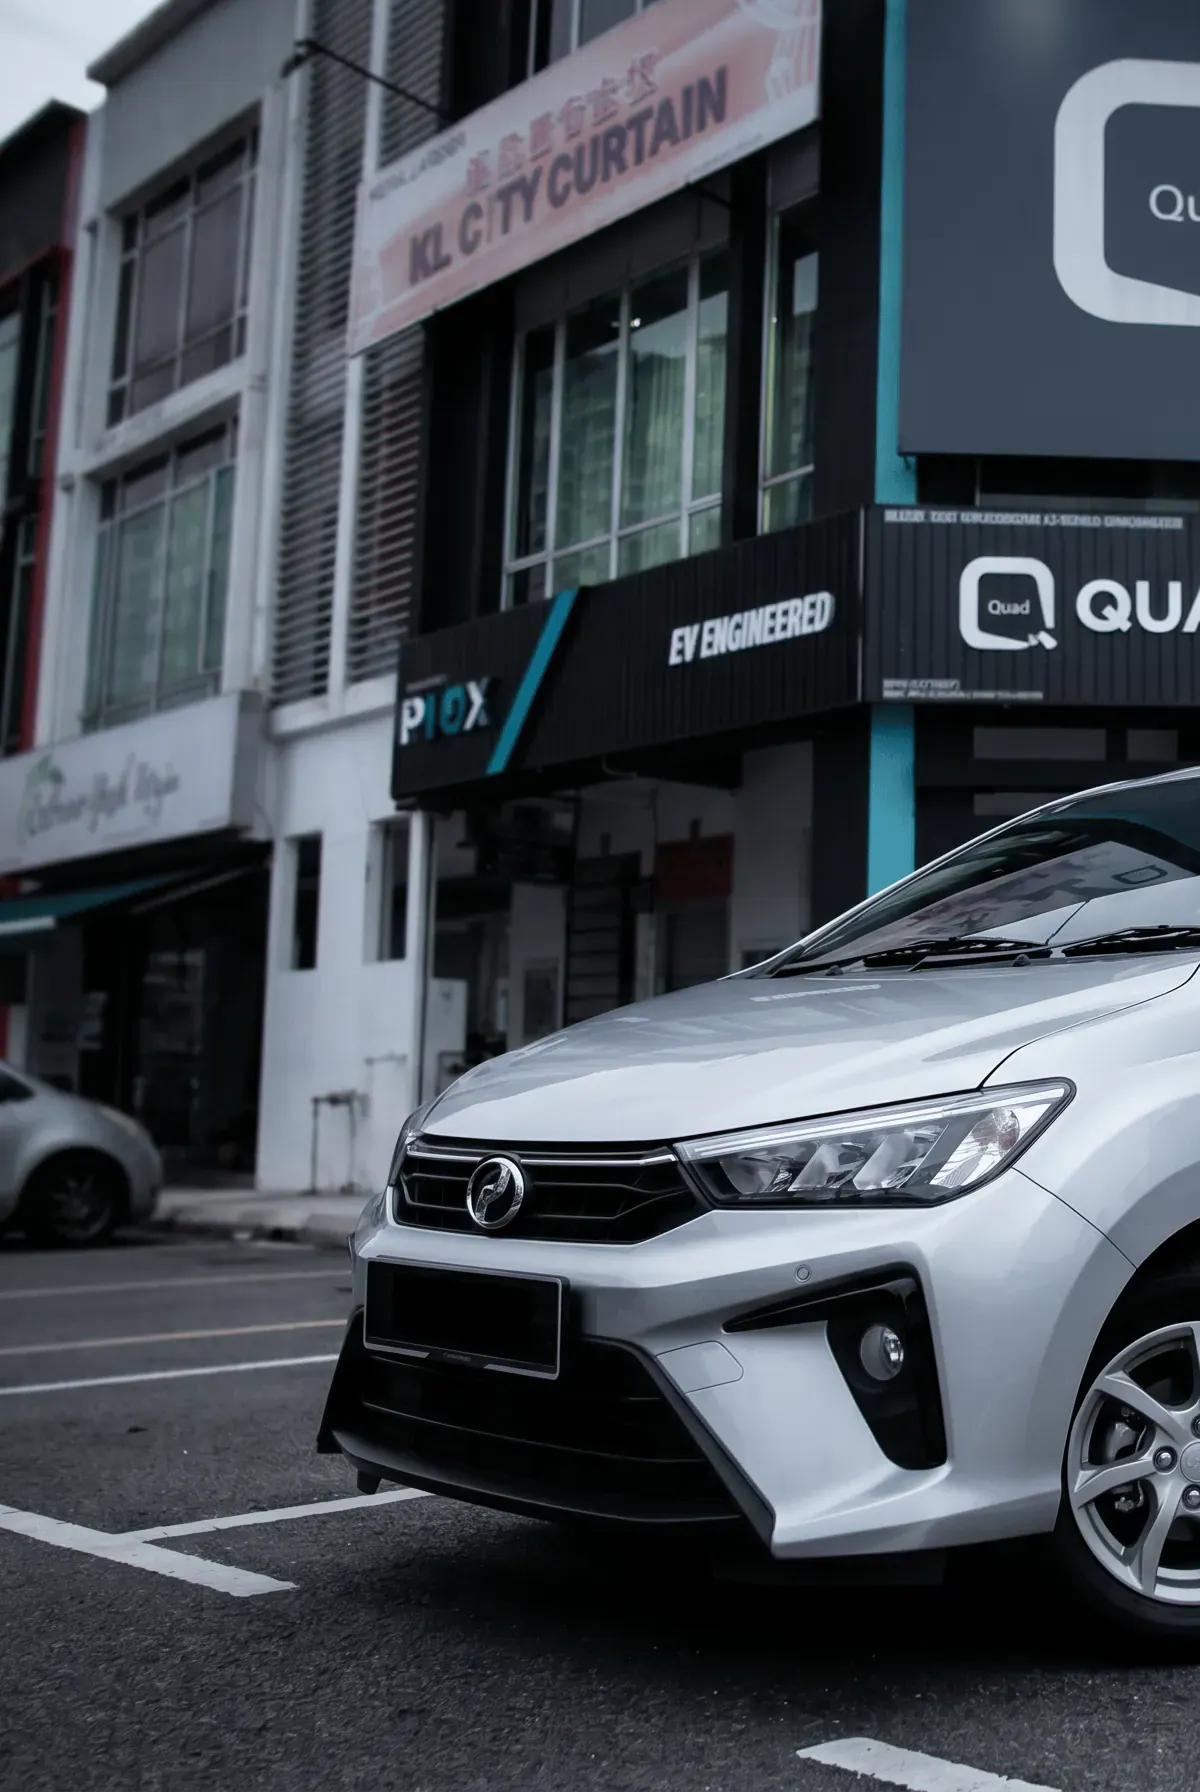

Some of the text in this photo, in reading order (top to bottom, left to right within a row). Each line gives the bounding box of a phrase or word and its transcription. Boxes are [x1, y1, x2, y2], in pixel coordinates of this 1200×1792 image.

[407, 221, 453, 285] KL
[457, 165, 543, 257] CITY
[545, 63, 728, 209] CURTAIN
[668, 590, 836, 666] EV ENGINEERED
[987, 598, 1031, 615] Quad
